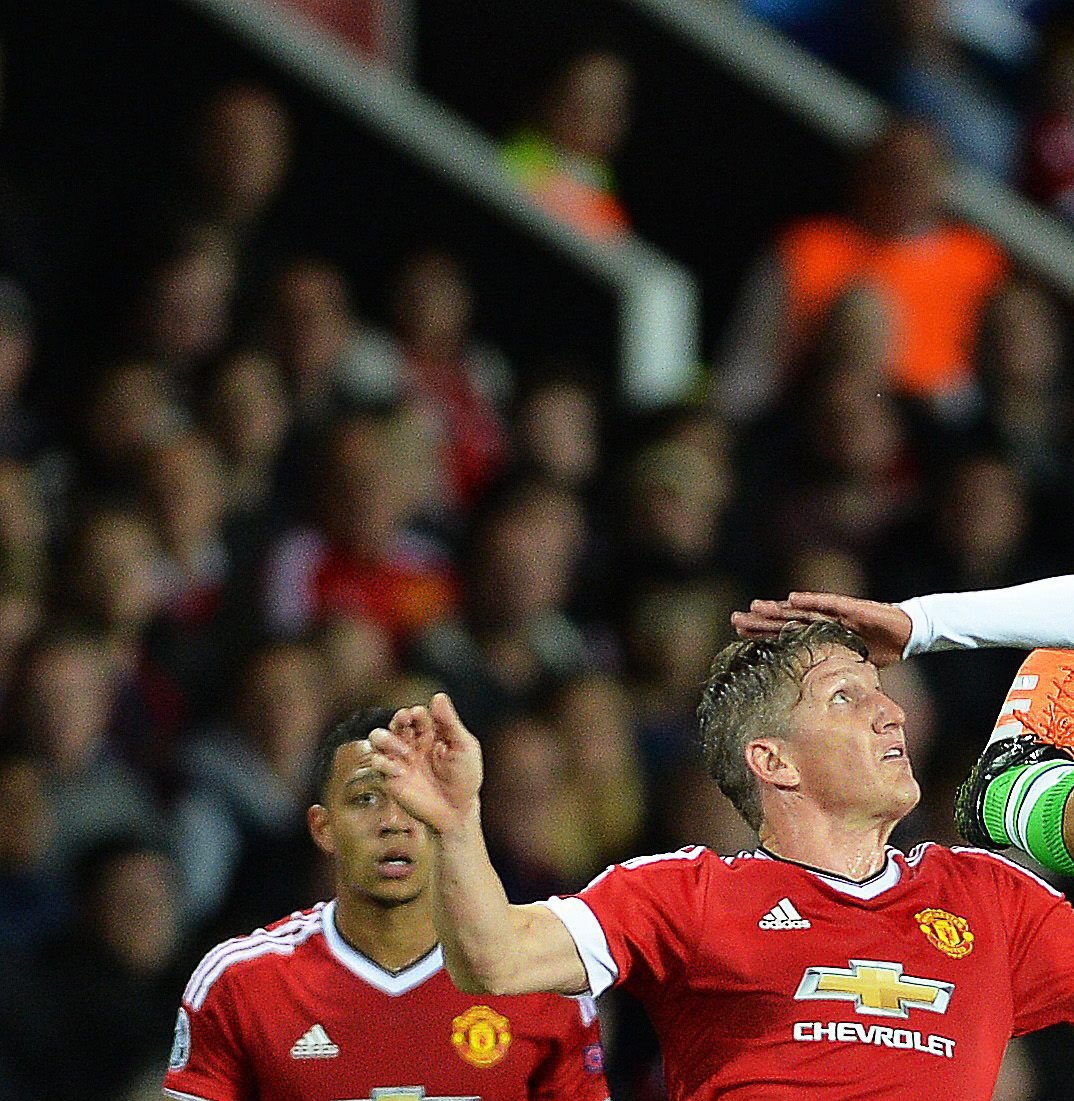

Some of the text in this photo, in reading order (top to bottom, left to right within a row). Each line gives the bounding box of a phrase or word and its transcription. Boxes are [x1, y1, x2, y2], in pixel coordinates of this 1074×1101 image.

[758, 918, 811, 930] adidas
[793, 1020, 956, 1059] CHEVROLET
[290, 1044, 339, 1060] adidas
